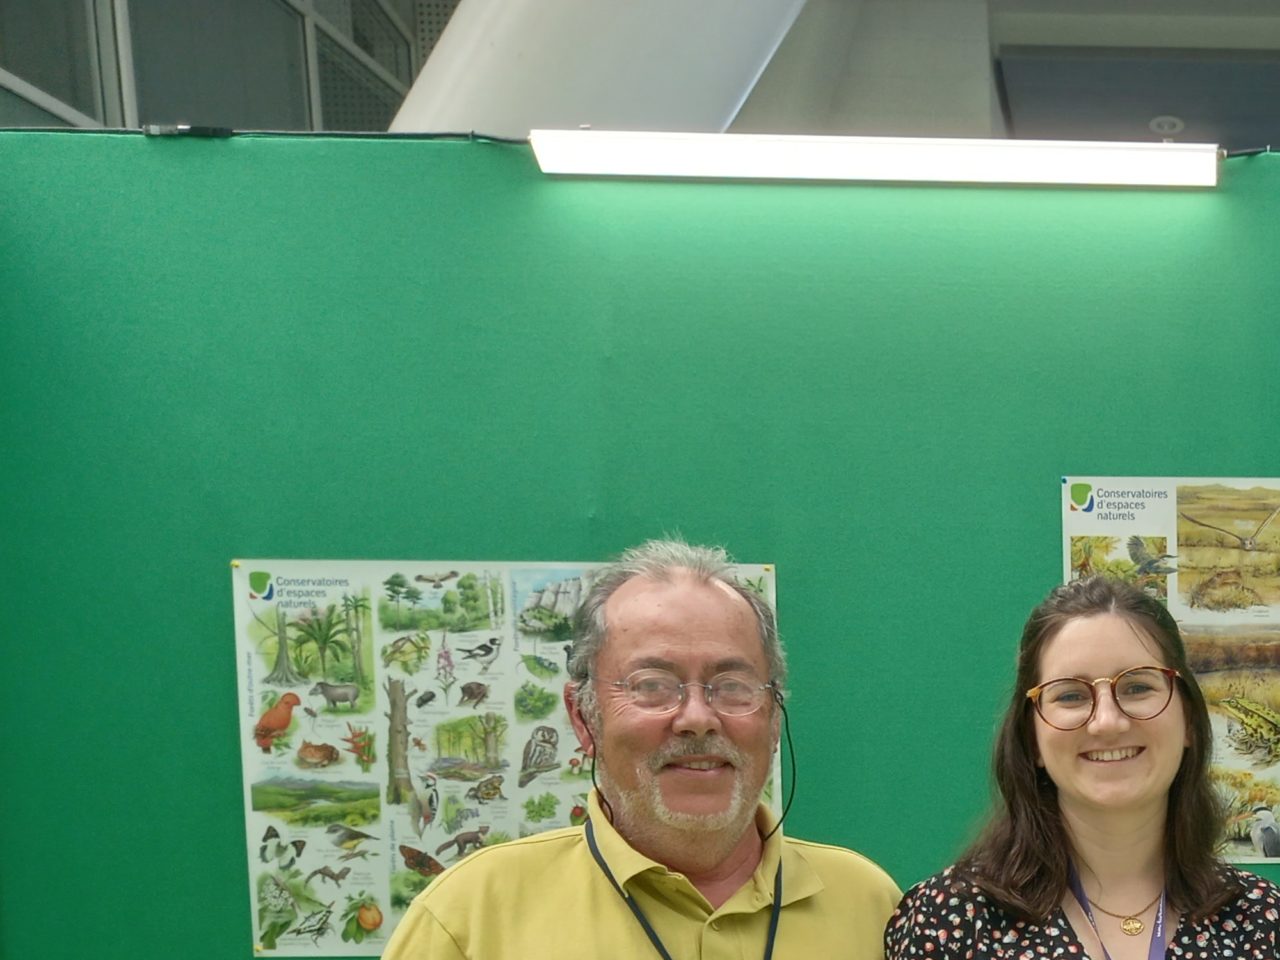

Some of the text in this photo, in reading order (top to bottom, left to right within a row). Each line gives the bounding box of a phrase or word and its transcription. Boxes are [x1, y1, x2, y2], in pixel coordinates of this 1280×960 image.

[1096, 488, 1168, 499] Conservatoires
[1096, 500, 1146, 511] d'espaces
[1097, 511, 1136, 521] naturels
[276, 576, 349, 587] Conservatoires
[276, 588, 327, 599] d'espaces
[277, 600, 317, 609] naturels
